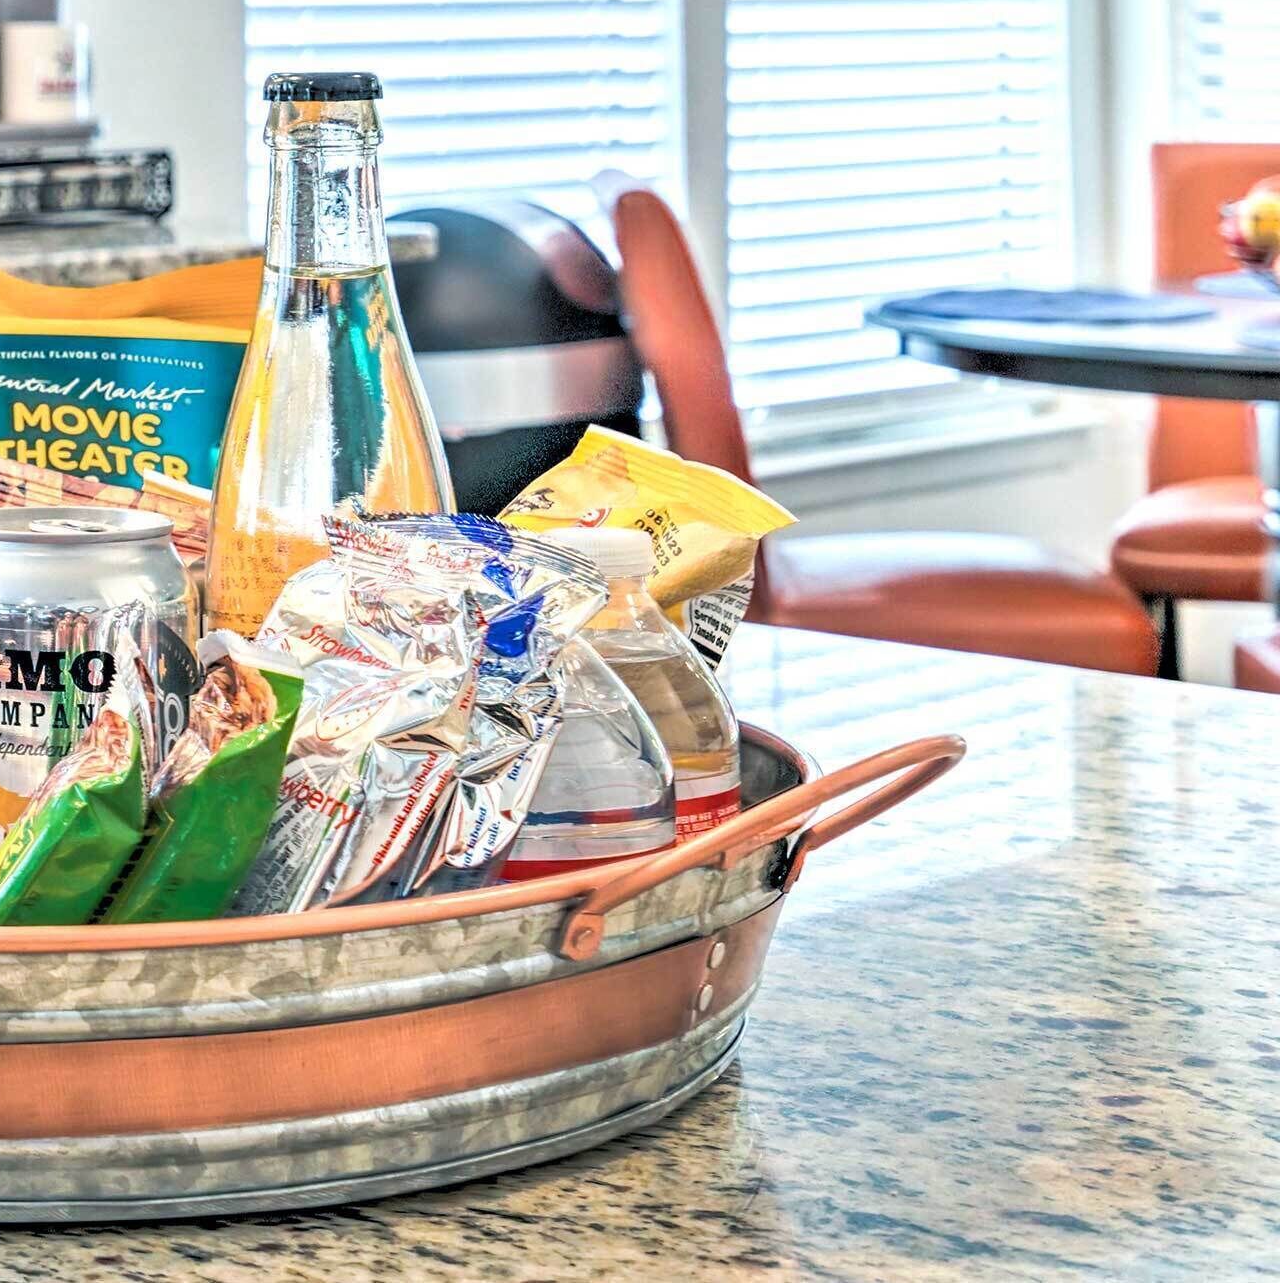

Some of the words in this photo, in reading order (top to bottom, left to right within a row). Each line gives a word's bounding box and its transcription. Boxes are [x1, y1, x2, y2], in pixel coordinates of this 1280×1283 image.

[49, 351, 98, 360] FLAVORS
[101, 352, 118, 361] OR
[120, 353, 204, 370] PRESERVATIVES
[79, 378, 205, 401] Market
[13, 402, 162, 447] MOVIE
[694, 609, 720, 632] Serving
[694, 623, 716, 644] Tamaño
[411, 750, 439, 794] labeled
